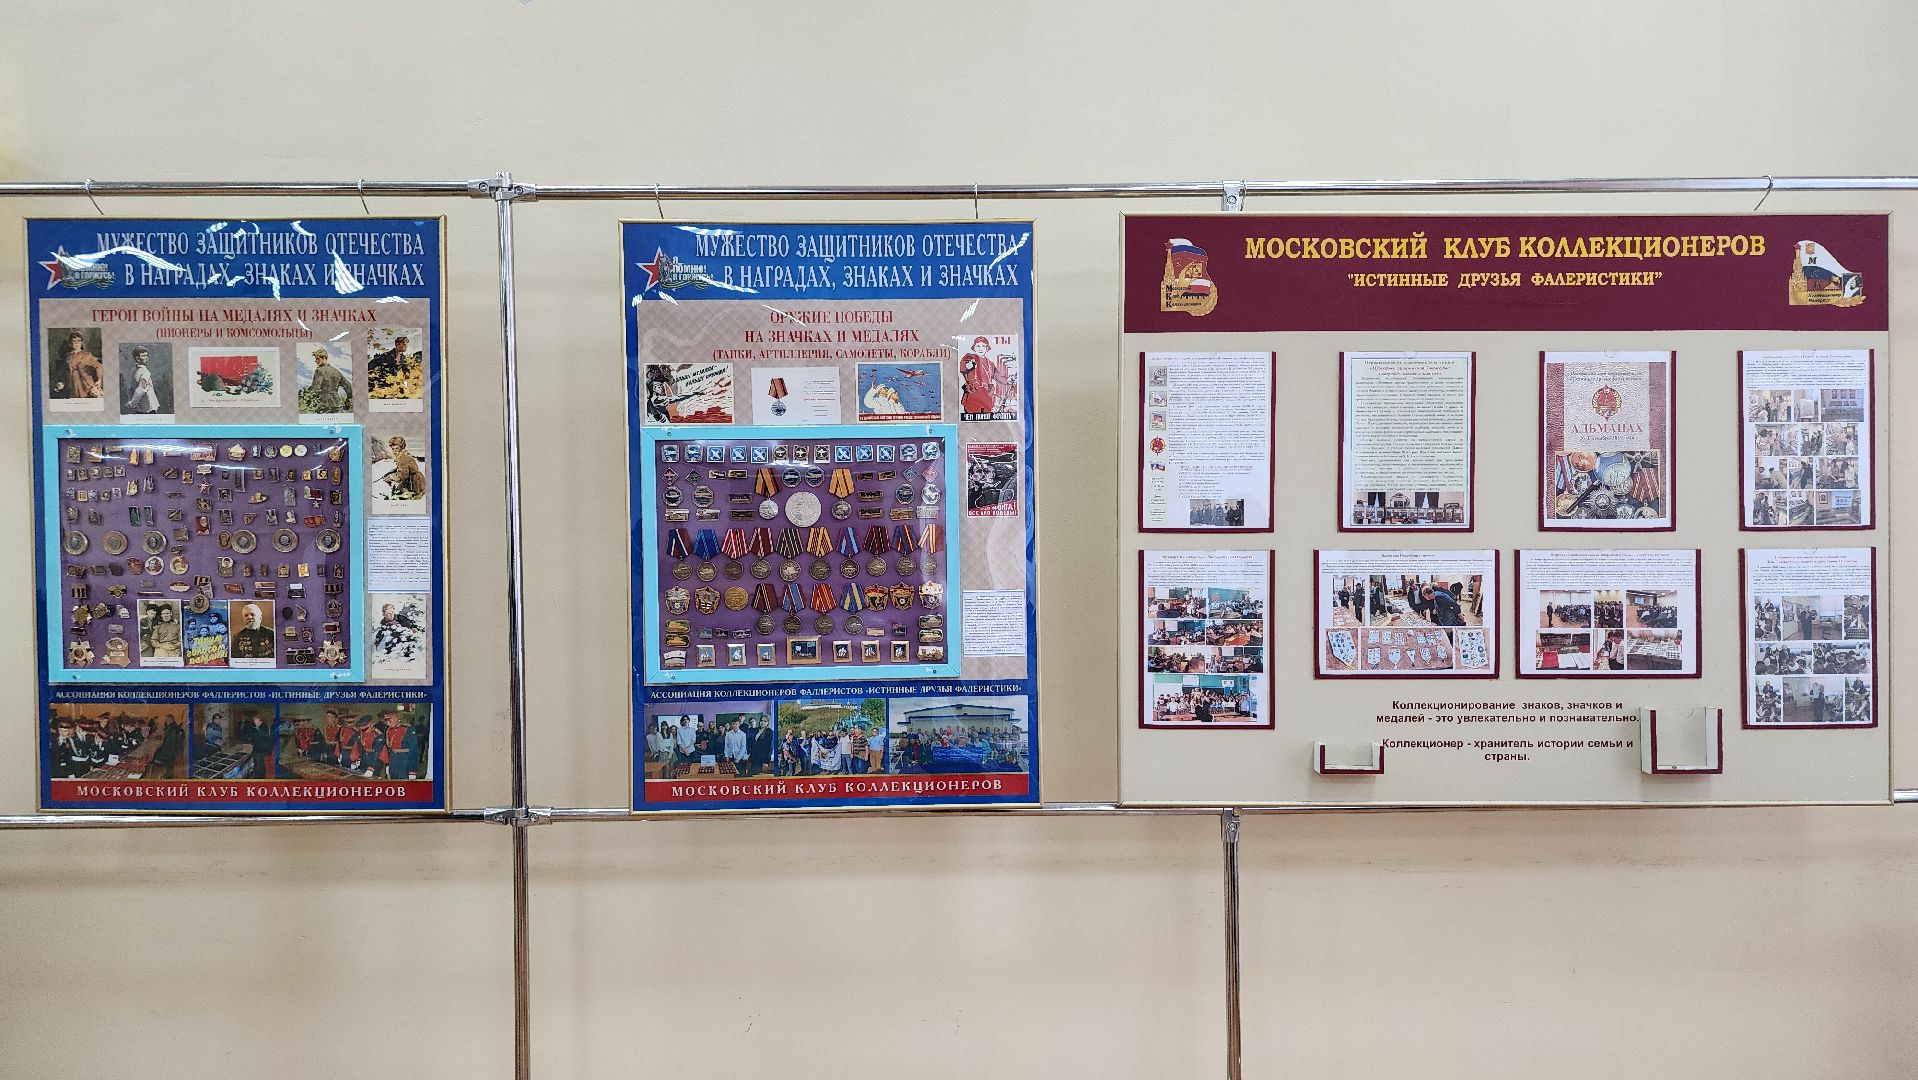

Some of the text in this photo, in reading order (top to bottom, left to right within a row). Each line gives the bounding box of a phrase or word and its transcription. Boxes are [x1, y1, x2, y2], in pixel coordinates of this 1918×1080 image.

[96, 232, 424, 260] МУЖЕСТВО ЗАЩИТНИКОВ ОТЕЧЕСТВА
[696, 234, 1018, 263] МУЖЕСТВО ЗАЩИТНИКОВ ОТЕЧЕСТВА
[1245, 232, 1766, 260] МОСКОВСКИЙ КЛУБ КОЛЛЕКЦИОНЕРОВ
[125, 263, 134, 286] В
[244, 262, 317, 286] ЗНАКАХ
[340, 264, 424, 286] НАЧКАХ
[724, 264, 1018, 292] В НАГРАДАХ, ЗНАКАХ И ЗНАЧКАХ
[1348, 273, 1448, 287] "ИСТИННЫЕ
[1458, 272, 1521, 288] ДРУЗЬЯ
[92, 307, 377, 324] ГЕРОИ ВОЙНЫ НА МЕДАЛЯХ И ЗНАЧКАХ
[770, 310, 893, 324] ОРУЖИЕ ПОБЕДЫ
[156, 328, 313, 340] (ПИОНЕРЫ И КОМСОМОЛЬЦЫ)
[745, 330, 919, 344] НА ЗНАЧКАХ И МЕДАЛЯХ
[712, 348, 951, 361] (ТАНКИ, АРТИЛЛЕРИЯ, САМОЛЕТЫ, КОРАБЛИ)
[1571, 424, 1643, 433] АЛЬМАНАХ
[56, 691, 116, 699] АССОЦИАЦИЯ
[118, 691, 200, 699] КОЛЛЕКЦИОНЕРОВ
[324, 691, 357, 699] ДРУЗЬЯ
[651, 690, 712, 699] АССОЦИАЦИЯ
[714, 689, 796, 698] КОЛЛЕКЦИОНЕРОВ
[920, 686, 952, 694] ДРУЗЬЯ
[1392, 700, 1623, 711] Коллекционирование знаков, значков и
[1376, 714, 1425, 723] медалей
[1457, 715, 1536, 724] увлекательно
[1382, 739, 1464, 750] Коллекционер
[1474, 740, 1534, 750] хранитель
[1537, 740, 1584, 750] истории
[1588, 740, 1623, 748] семьи
[1626, 740, 1633, 748] и
[1484, 753, 1530, 762] страны.
[76, 784, 406, 798] МОСКОВСКИЙ КЛУБ КОЛЛЕКЦИОНЕРОВ
[671, 779, 1002, 797] МОСКОВСКИЙ КЛУБ КОЛЛЕКЦИОНЕРОВ
